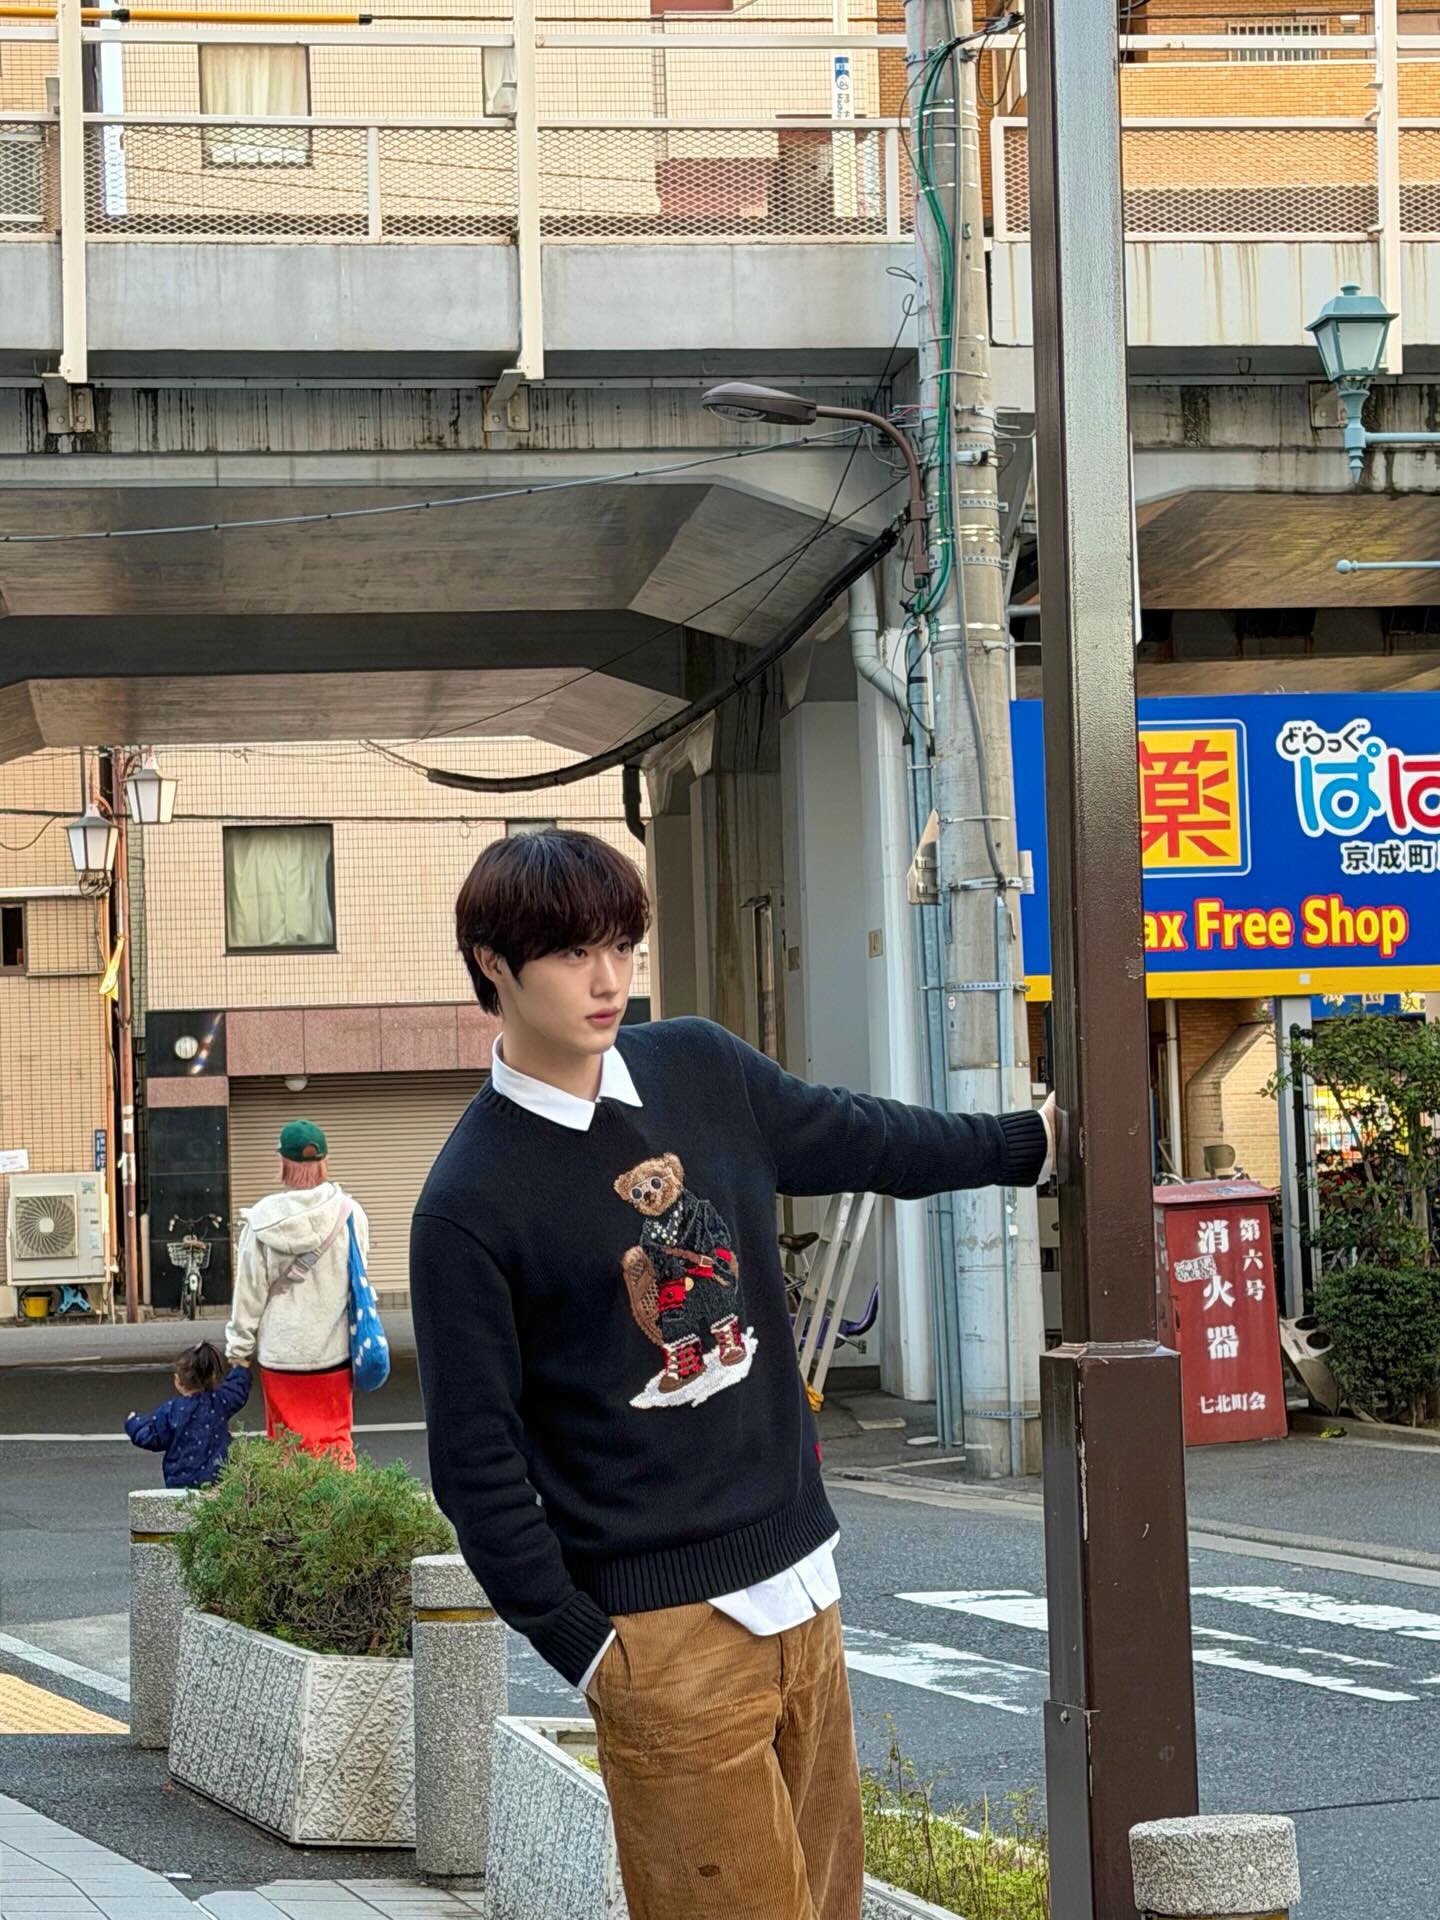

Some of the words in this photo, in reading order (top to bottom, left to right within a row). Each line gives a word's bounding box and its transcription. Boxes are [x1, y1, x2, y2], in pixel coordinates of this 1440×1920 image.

[1281, 724, 1367, 756] どらっぐ
[1139, 739, 1232, 859] 薬
[1344, 843, 1440, 871] 京成町
[1145, 912, 1187, 950] ax
[1196, 899, 1293, 949] Free
[1303, 895, 1407, 956] Shop
[1198, 1219, 1239, 1360] 消火器
[1240, 1218, 1266, 1301] 第六号
[1197, 1391, 1266, 1414] 七北町会
